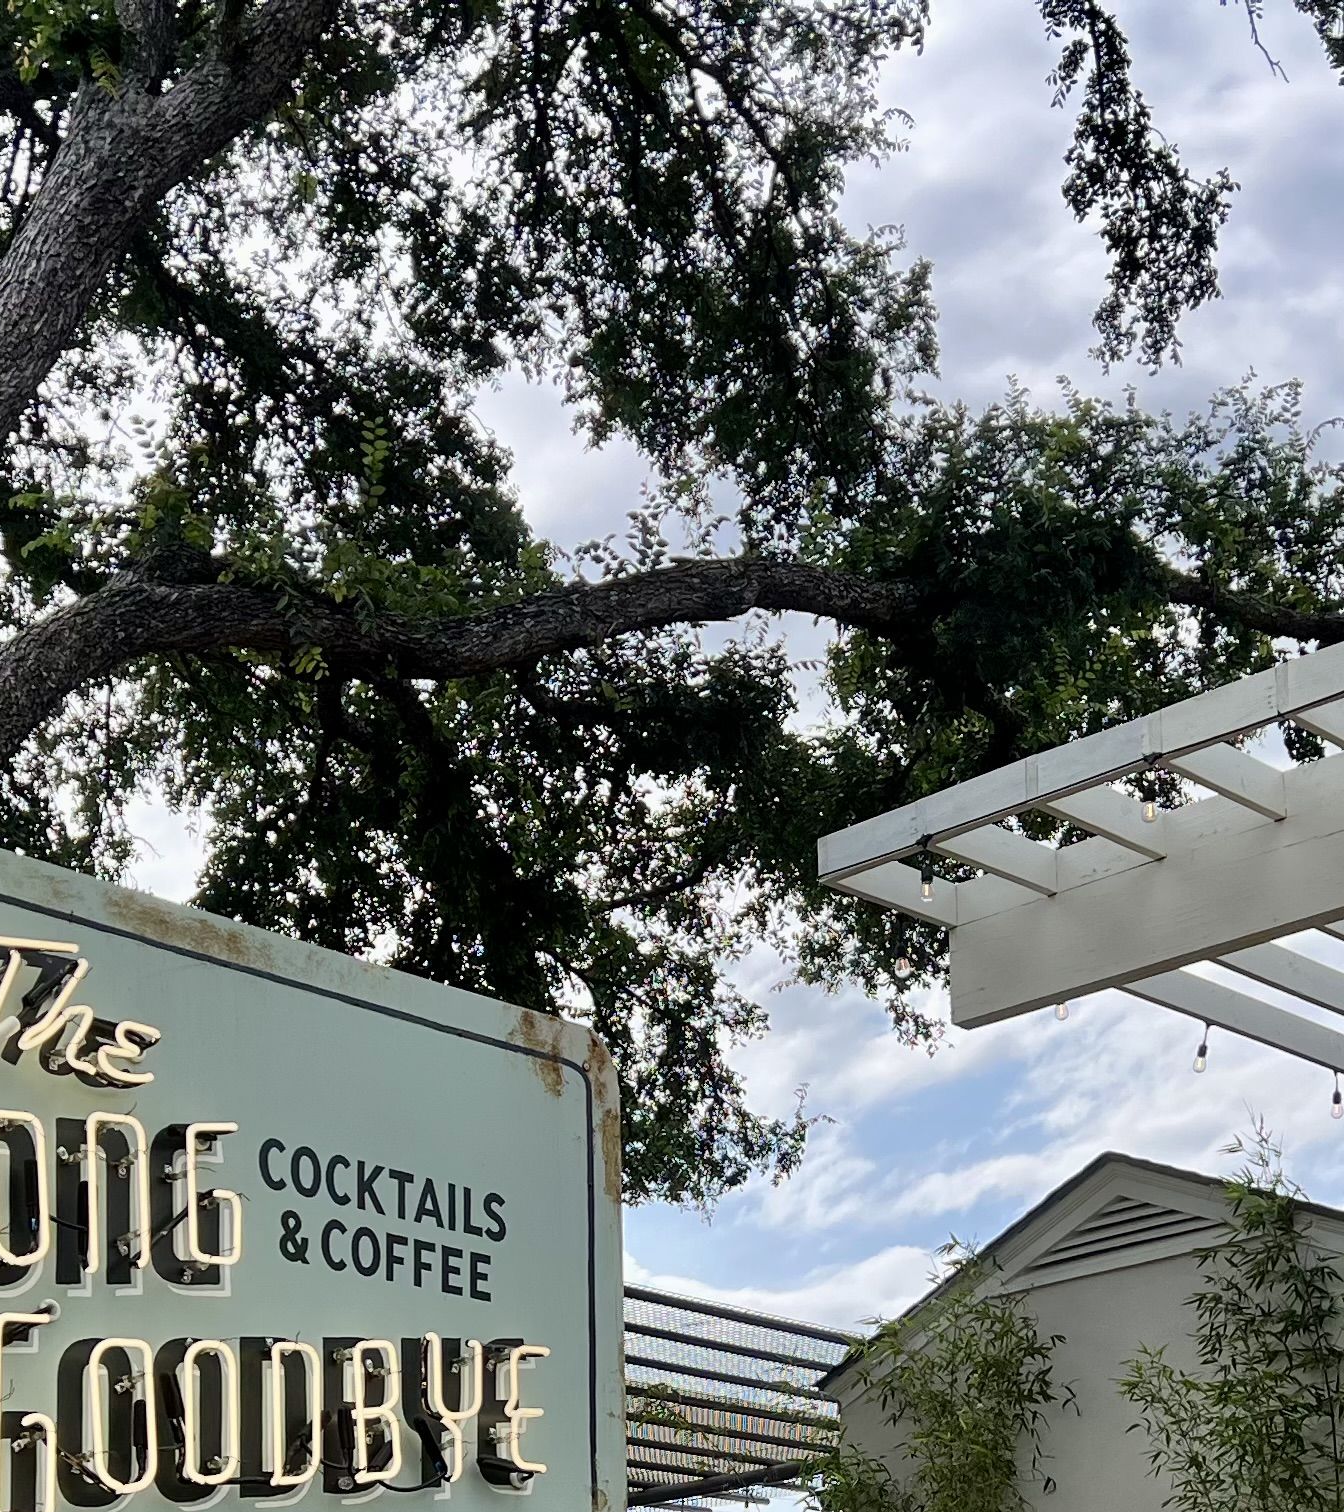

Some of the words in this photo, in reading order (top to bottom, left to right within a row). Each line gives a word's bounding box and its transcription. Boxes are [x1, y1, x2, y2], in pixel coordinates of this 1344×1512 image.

[258, 1137, 507, 1242] COCKTAILS
[279, 1209, 311, 1265] &
[321, 1218, 492, 1303] COFFEE
